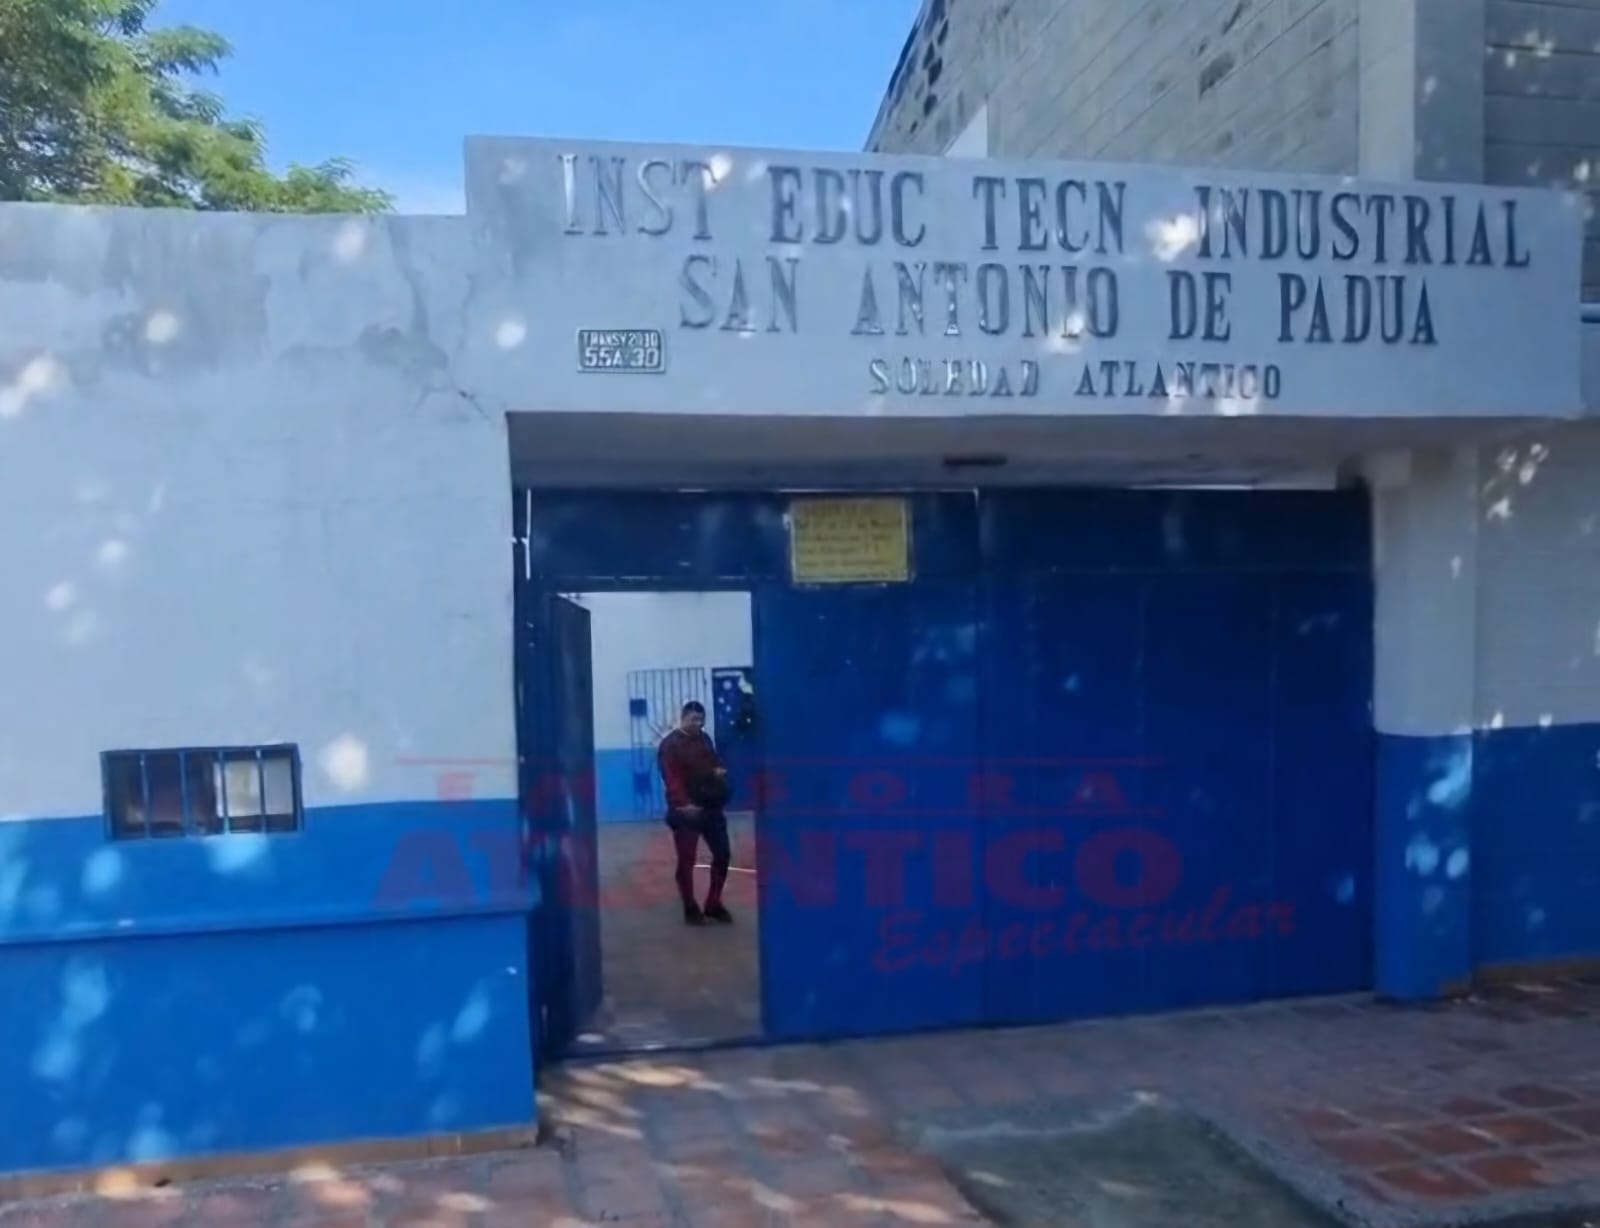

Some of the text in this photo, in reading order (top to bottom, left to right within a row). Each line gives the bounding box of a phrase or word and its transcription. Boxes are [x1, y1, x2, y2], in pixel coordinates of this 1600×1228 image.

[557, 152, 1531, 268] INST EDUC TECN INDUSTRIAL
[679, 253, 1438, 345] SAN ANTONIO DE PADUA
[630, 347, 660, 367] 30
[869, 357, 1281, 399] SOLEDAD ATLANTICO
